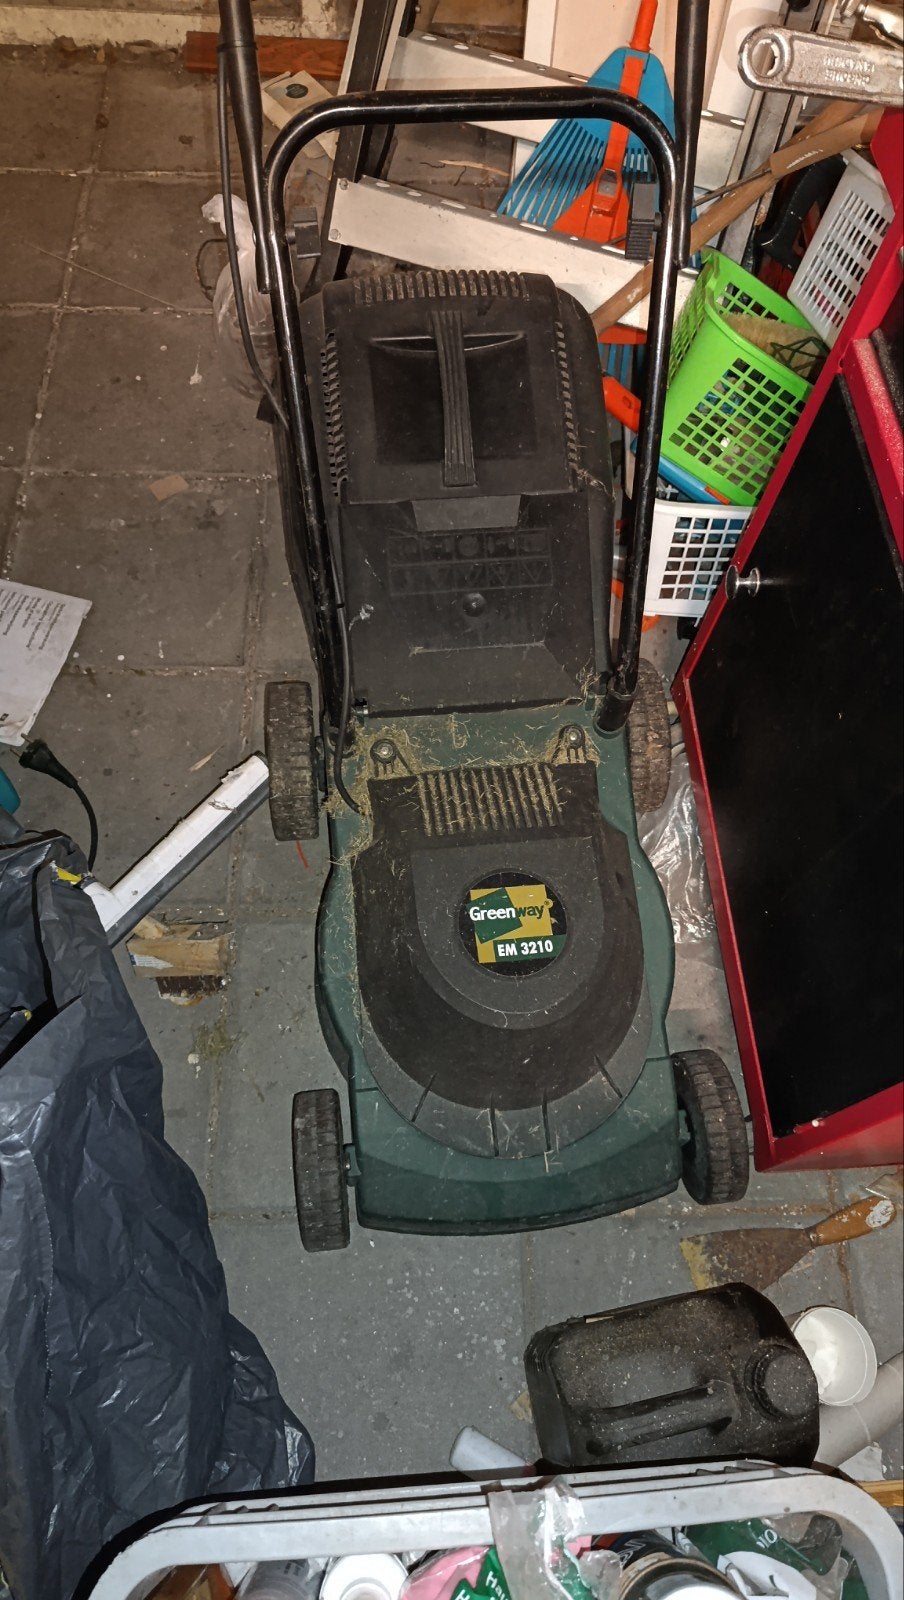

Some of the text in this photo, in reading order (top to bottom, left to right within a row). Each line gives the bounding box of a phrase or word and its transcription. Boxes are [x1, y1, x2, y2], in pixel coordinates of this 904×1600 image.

[469, 904, 545, 921] Greenway
[497, 940, 554, 957] EM 3210
